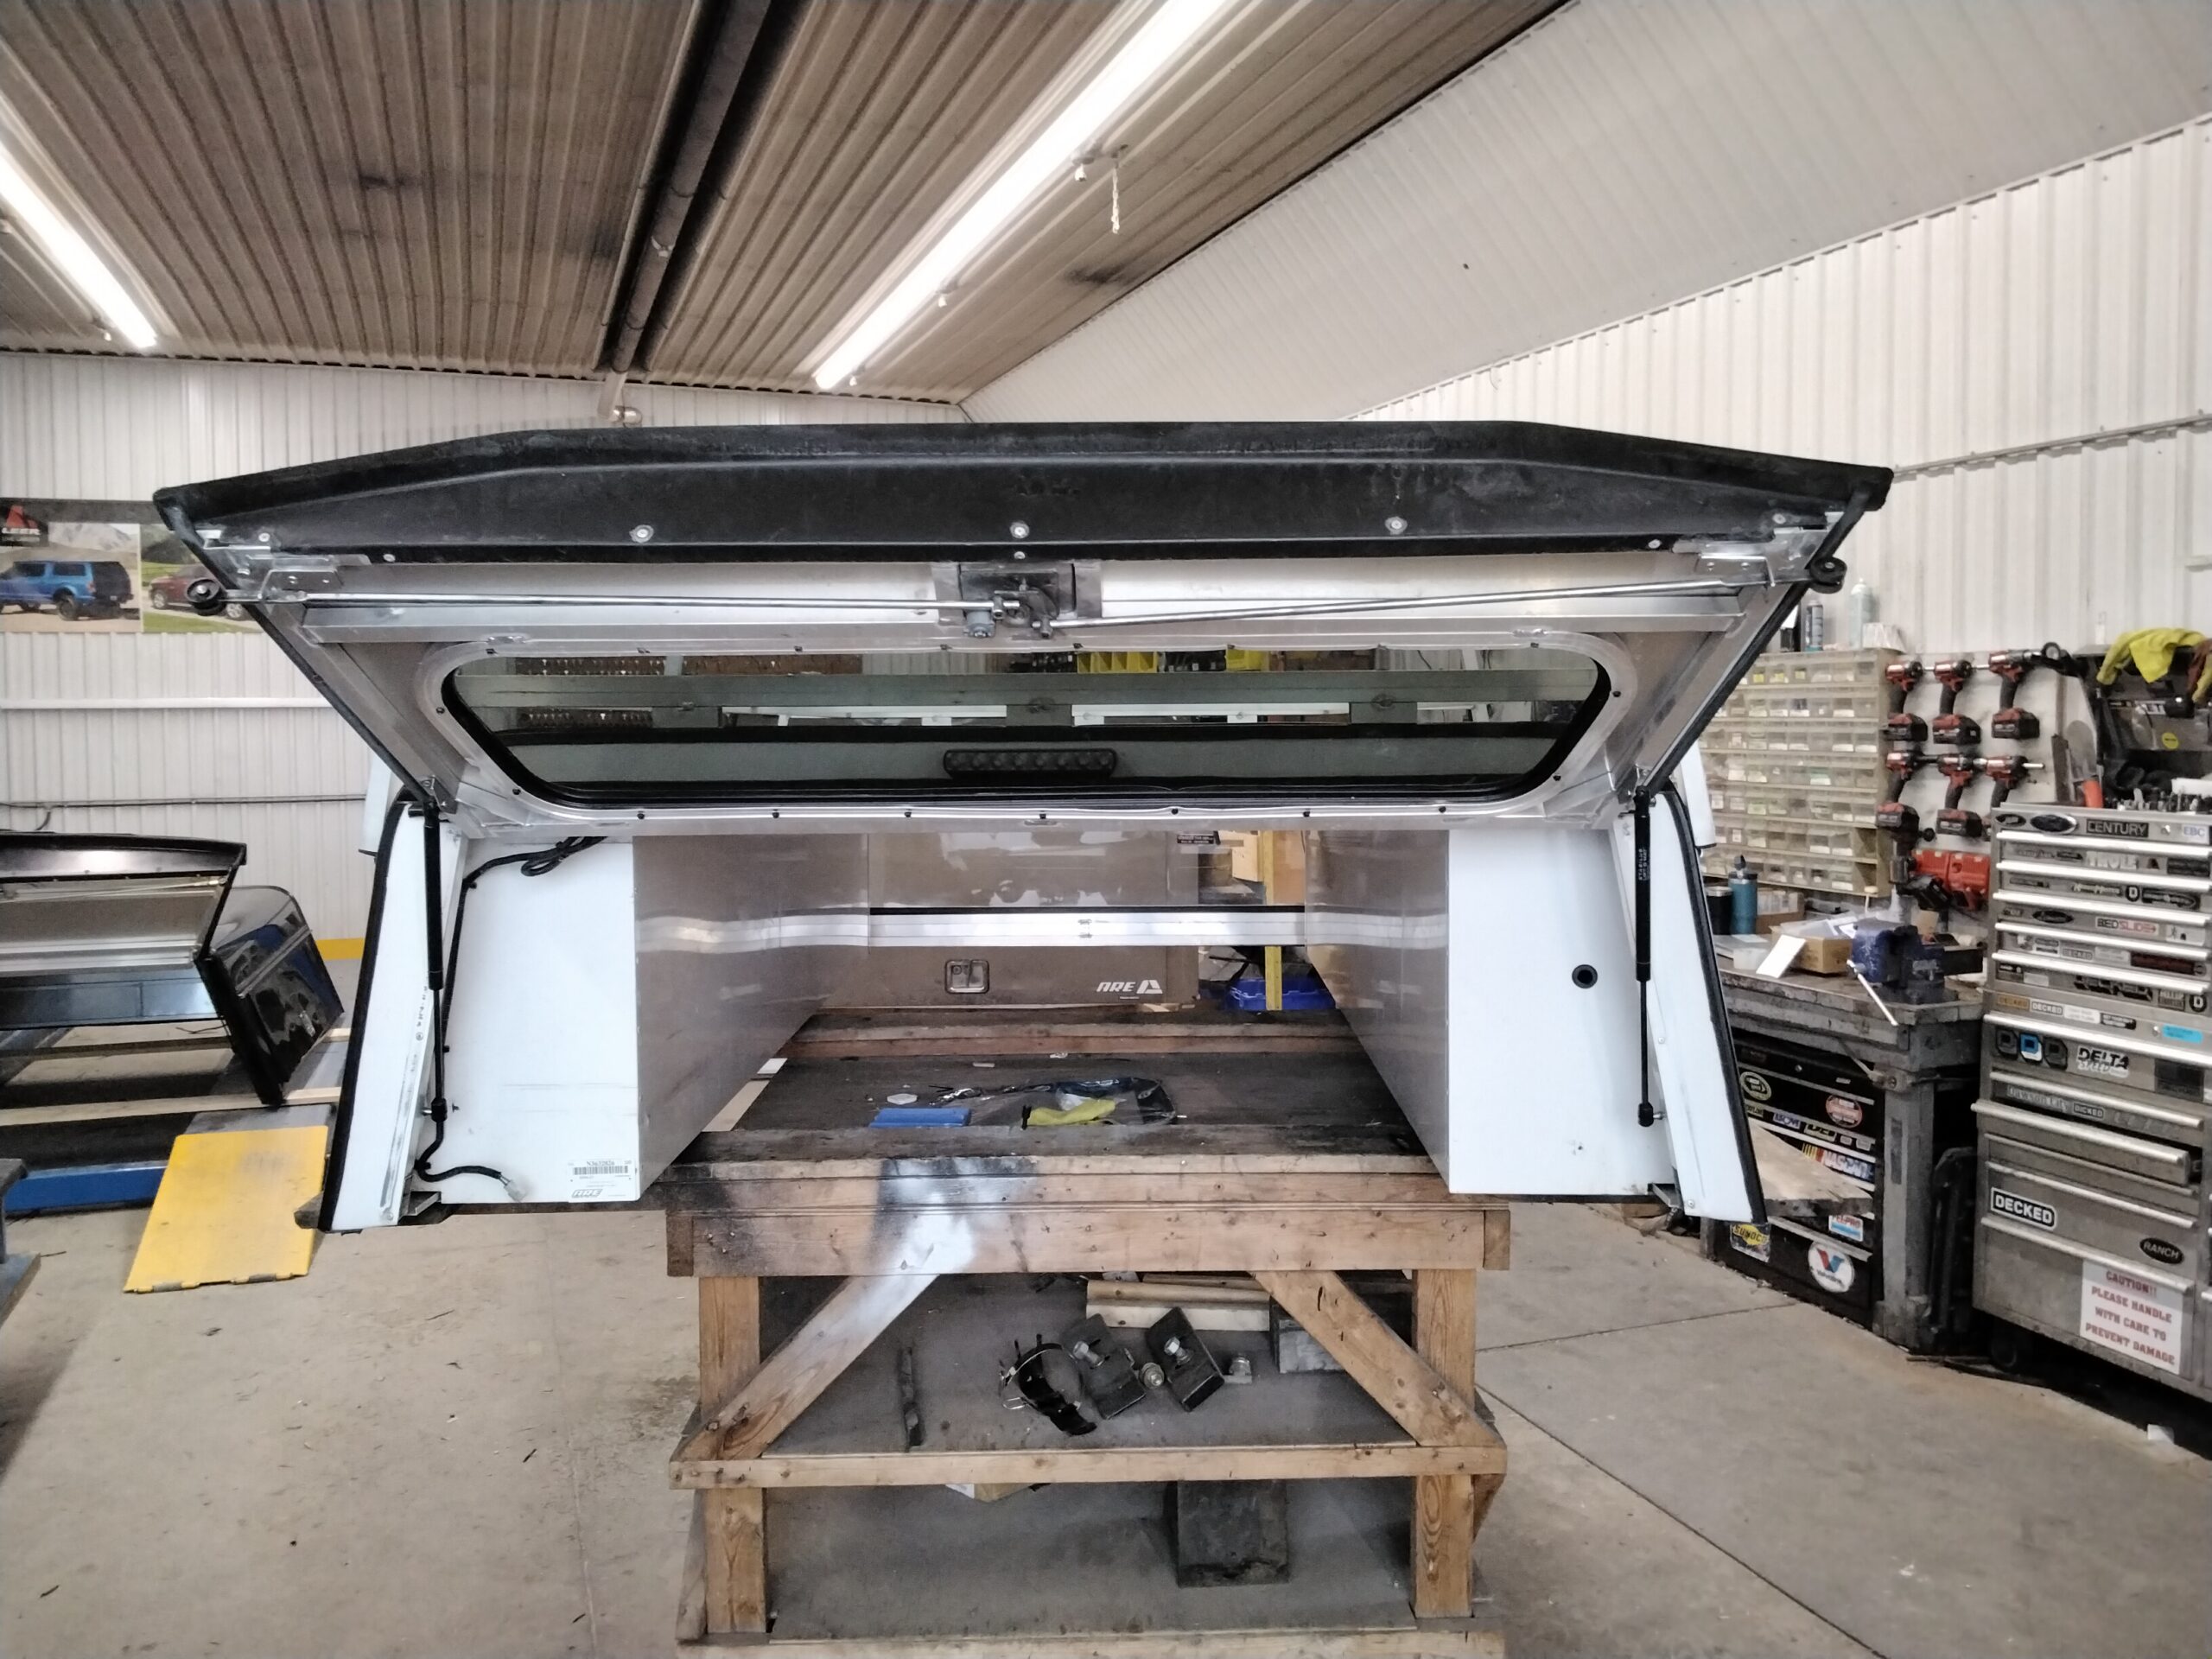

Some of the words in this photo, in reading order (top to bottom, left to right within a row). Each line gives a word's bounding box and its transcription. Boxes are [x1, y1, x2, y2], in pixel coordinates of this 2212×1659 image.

[2087, 820, 2147, 837] CENTURY
[2183, 826, 2206, 837] EBC
[2032, 1002, 2063, 1015] DECKED
[2077, 1046, 2130, 1070] DELTA
[1994, 1194, 2053, 1225] DECKED
[2143, 1240, 2180, 1260] RANCH
[2091, 1286, 2129, 1307] PLEASE
[2131, 1300, 2172, 1324] HANDLE
[2094, 1306, 2121, 1324] WITH
[2123, 1317, 2150, 1335] CARE
[2152, 1327, 2167, 1342] TO
[2085, 1322, 2132, 1347] PREVENT
[2133, 1340, 2176, 1365] DAMAGE
